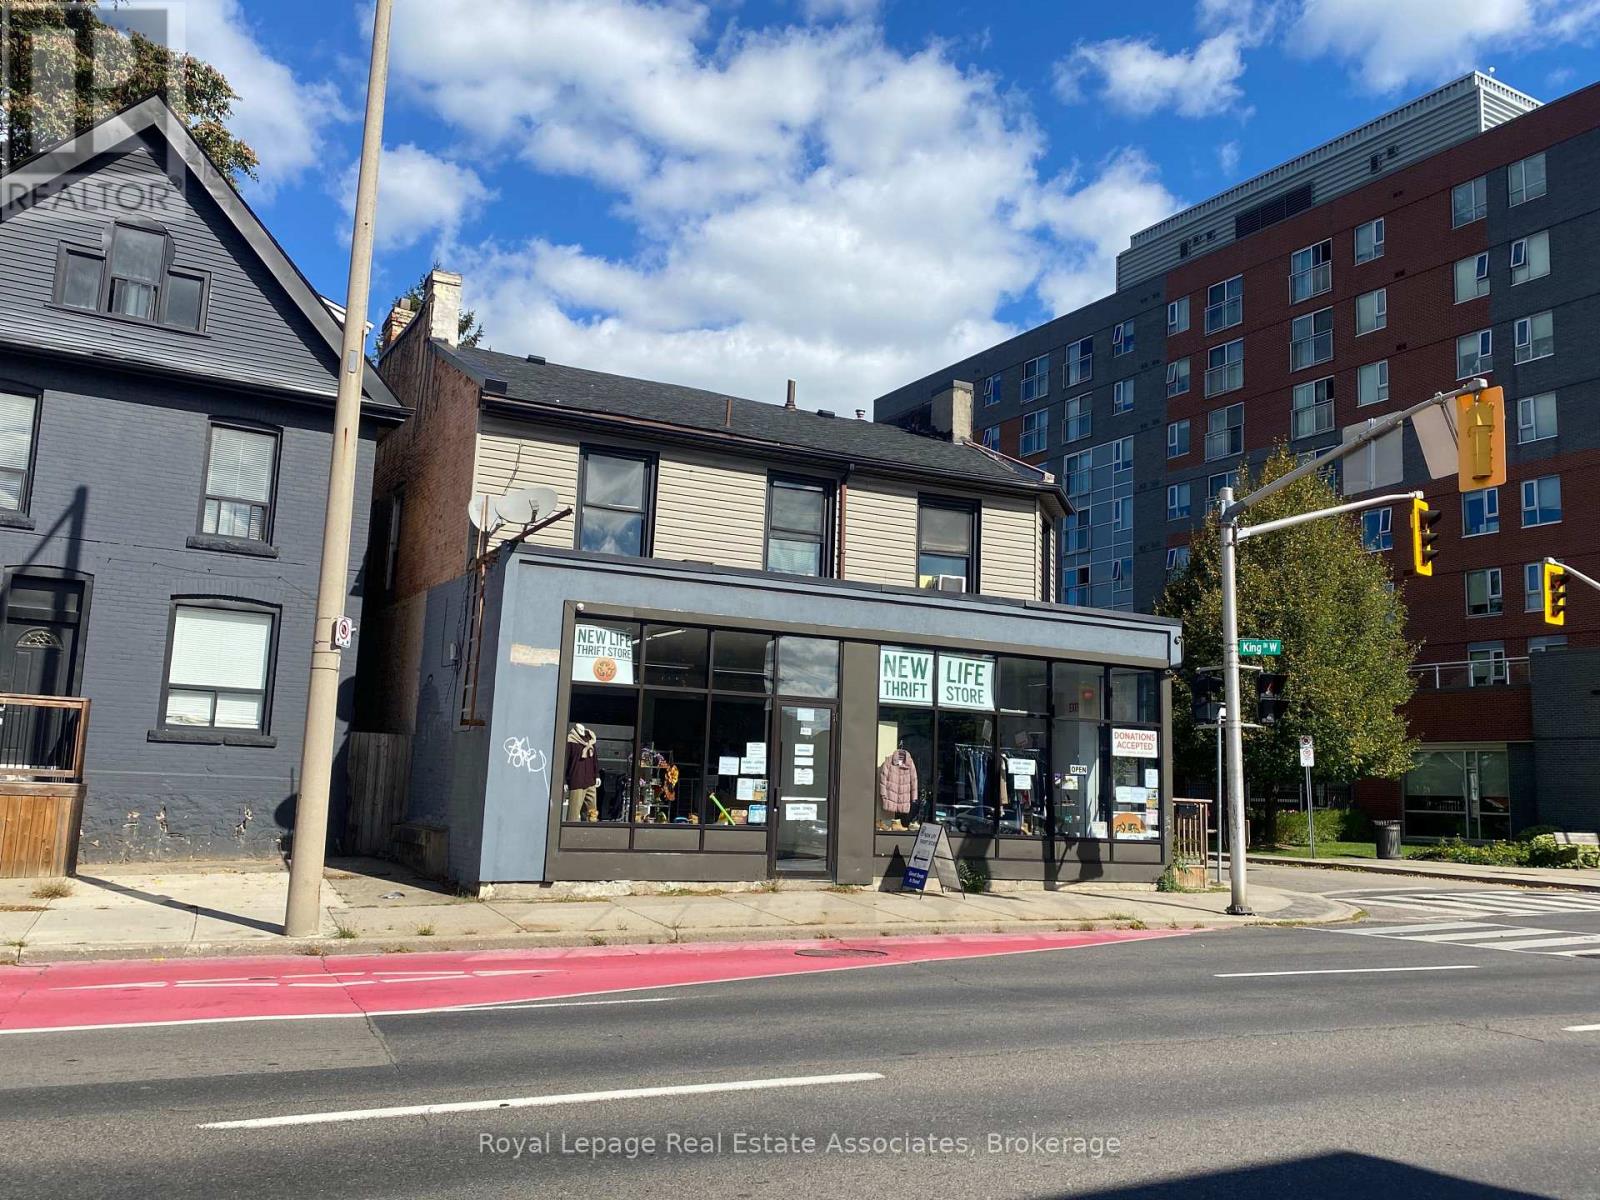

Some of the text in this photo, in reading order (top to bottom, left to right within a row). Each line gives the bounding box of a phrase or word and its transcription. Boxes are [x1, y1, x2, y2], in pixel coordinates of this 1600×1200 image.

[578, 628, 632, 648] NEW LIFE
[577, 645, 632, 659] THRIFT STORE
[1243, 641, 1262, 655] King
[1269, 642, 1278, 652] W
[883, 654, 986, 686] NEW LIFE
[883, 680, 985, 705] THRIFT STORE
[1114, 731, 1156, 742] DONATIONS
[1116, 740, 1154, 751] ACCEPTED
